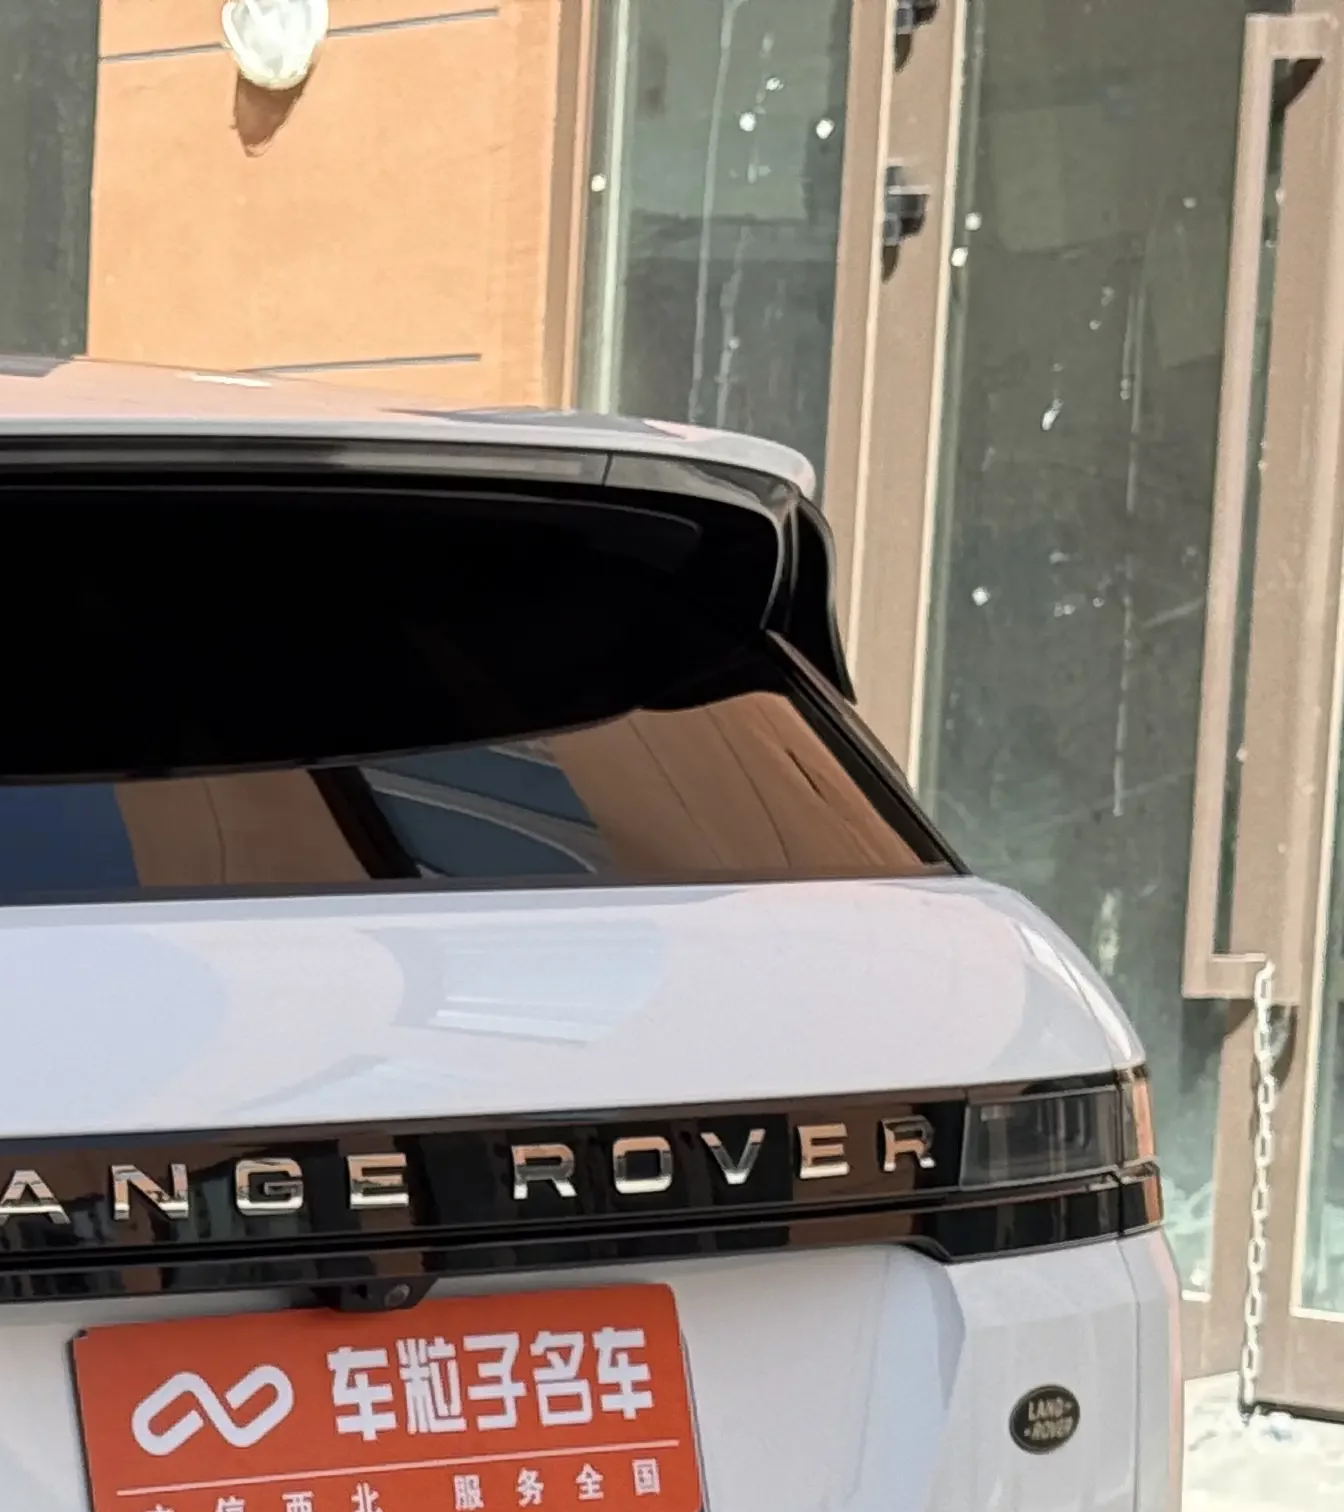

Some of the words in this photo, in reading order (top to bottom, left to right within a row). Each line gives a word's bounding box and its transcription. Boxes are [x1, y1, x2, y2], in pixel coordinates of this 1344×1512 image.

[509, 1117, 937, 1200] ROVER
[327, 1326, 653, 1441] 车粒子名车
[453, 1457, 661, 1512] 服务全国
